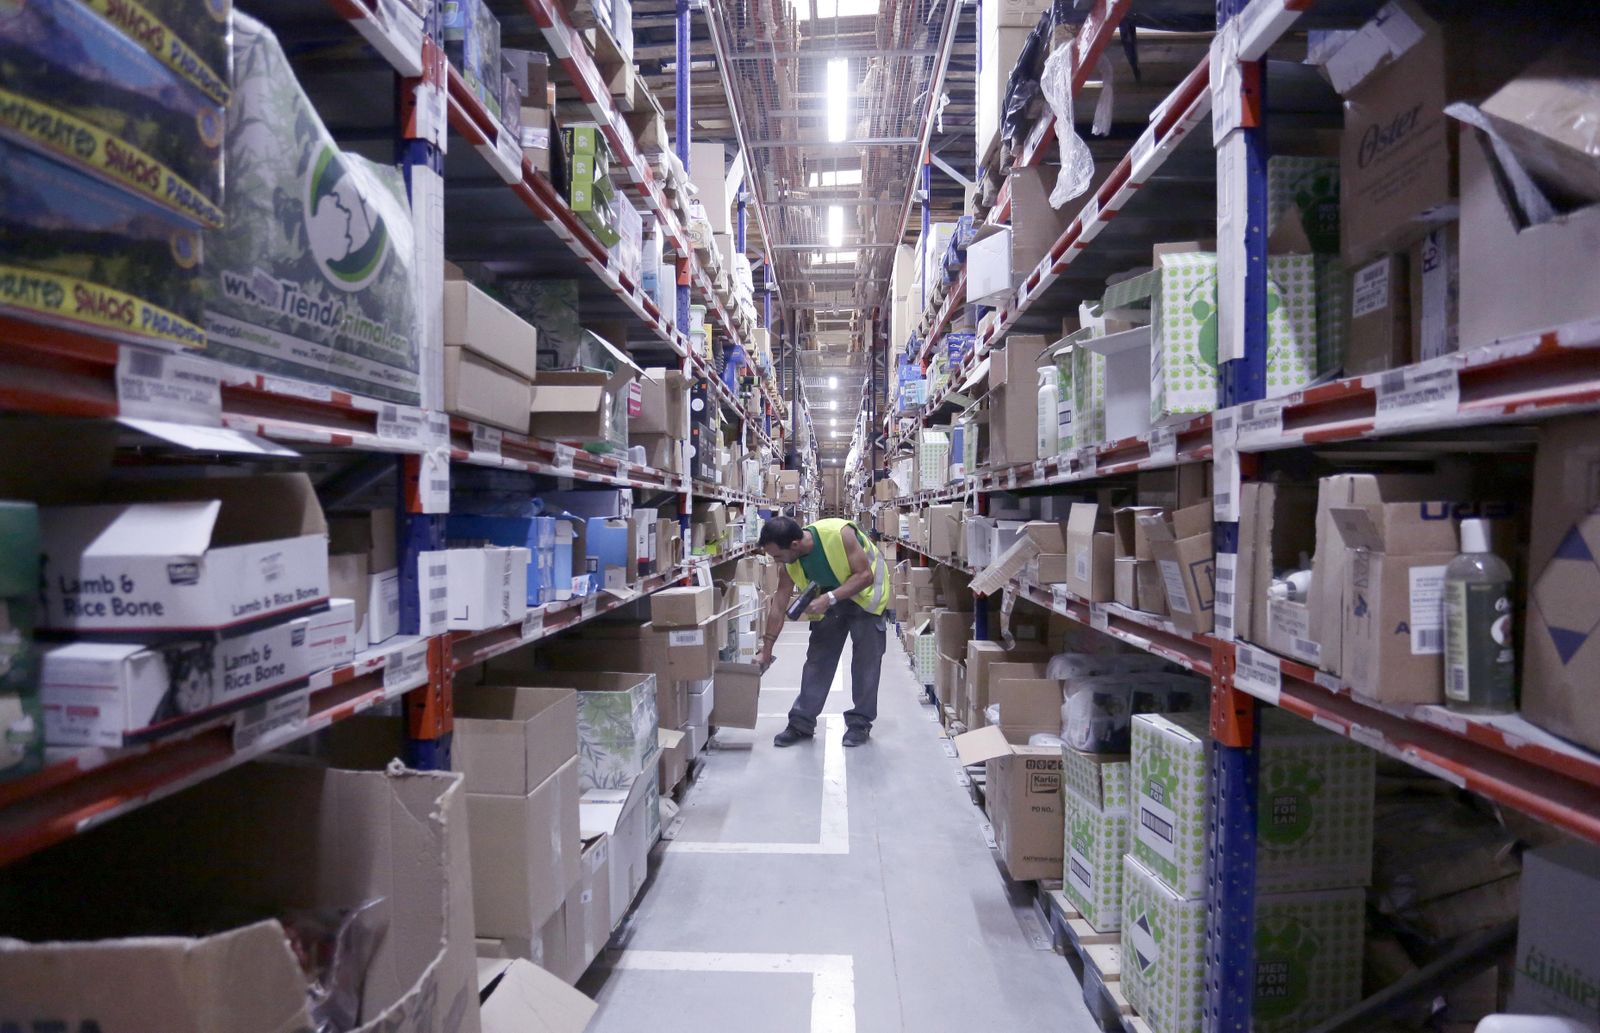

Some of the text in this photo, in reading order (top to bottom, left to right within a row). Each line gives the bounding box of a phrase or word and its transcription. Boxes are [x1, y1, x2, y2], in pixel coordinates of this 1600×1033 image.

[60, 574, 134, 594] Lamb &
[64, 596, 164, 617] Rice Bone
[232, 587, 319, 616] Lamb & Rice Bone
[224, 643, 272, 672] Lamb &
[224, 663, 285, 692] Rice Bone
[1034, 775, 1058, 784] Karlie
[1273, 805, 1297, 815] FOR
[1273, 815, 1297, 825] SAN
[1257, 962, 1288, 974] MEN
[1257, 973, 1288, 985] FOR
[1257, 985, 1288, 997] SAN
